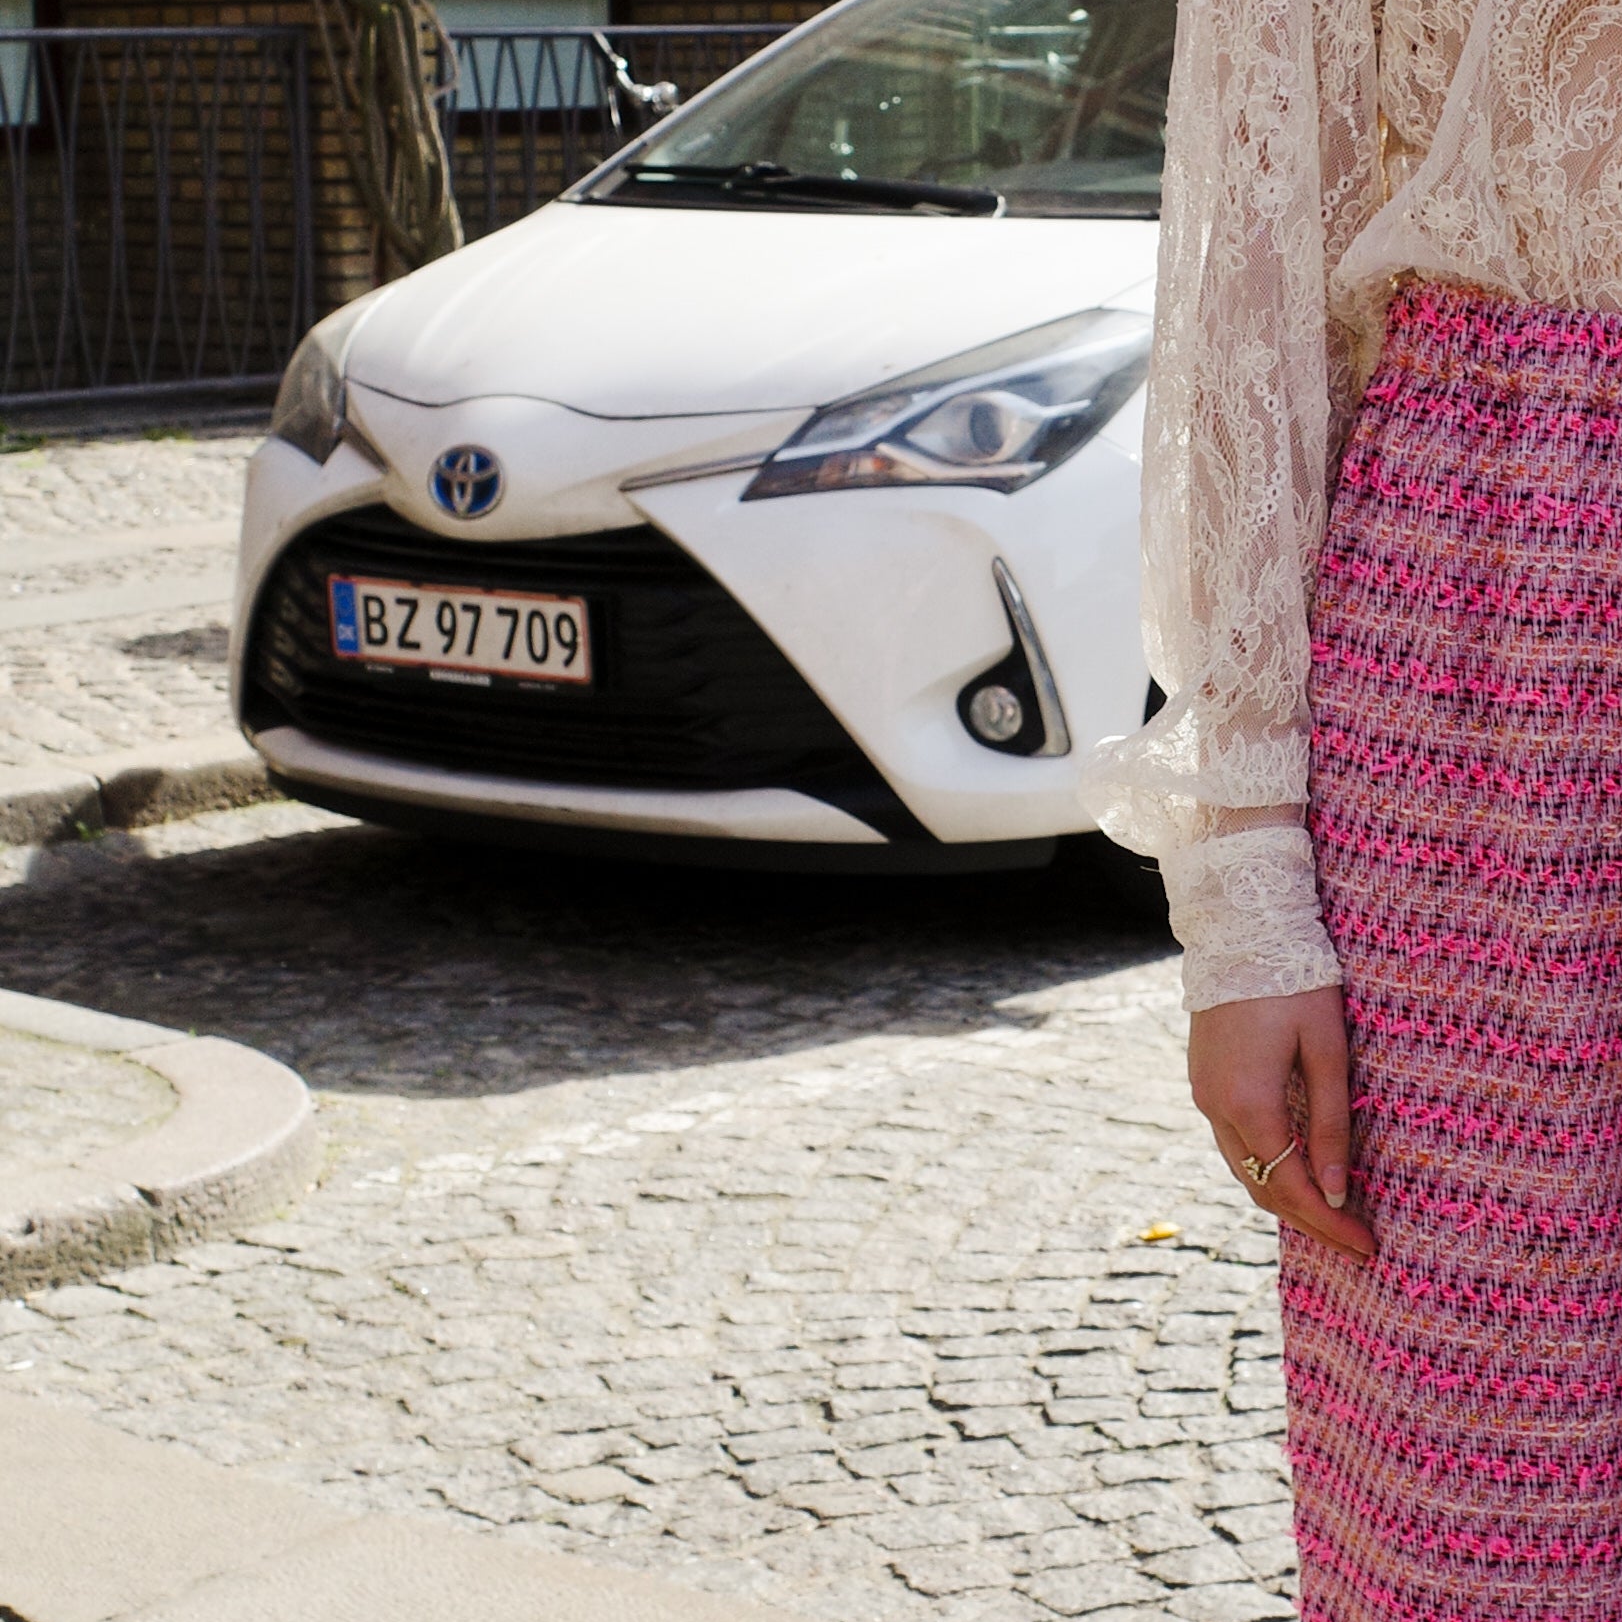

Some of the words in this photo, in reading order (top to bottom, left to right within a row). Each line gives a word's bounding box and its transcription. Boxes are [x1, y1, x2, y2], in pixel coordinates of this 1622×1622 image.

[363, 595, 421, 650] BZ
[436, 600, 481, 656] 97
[497, 607, 578, 668] 709
